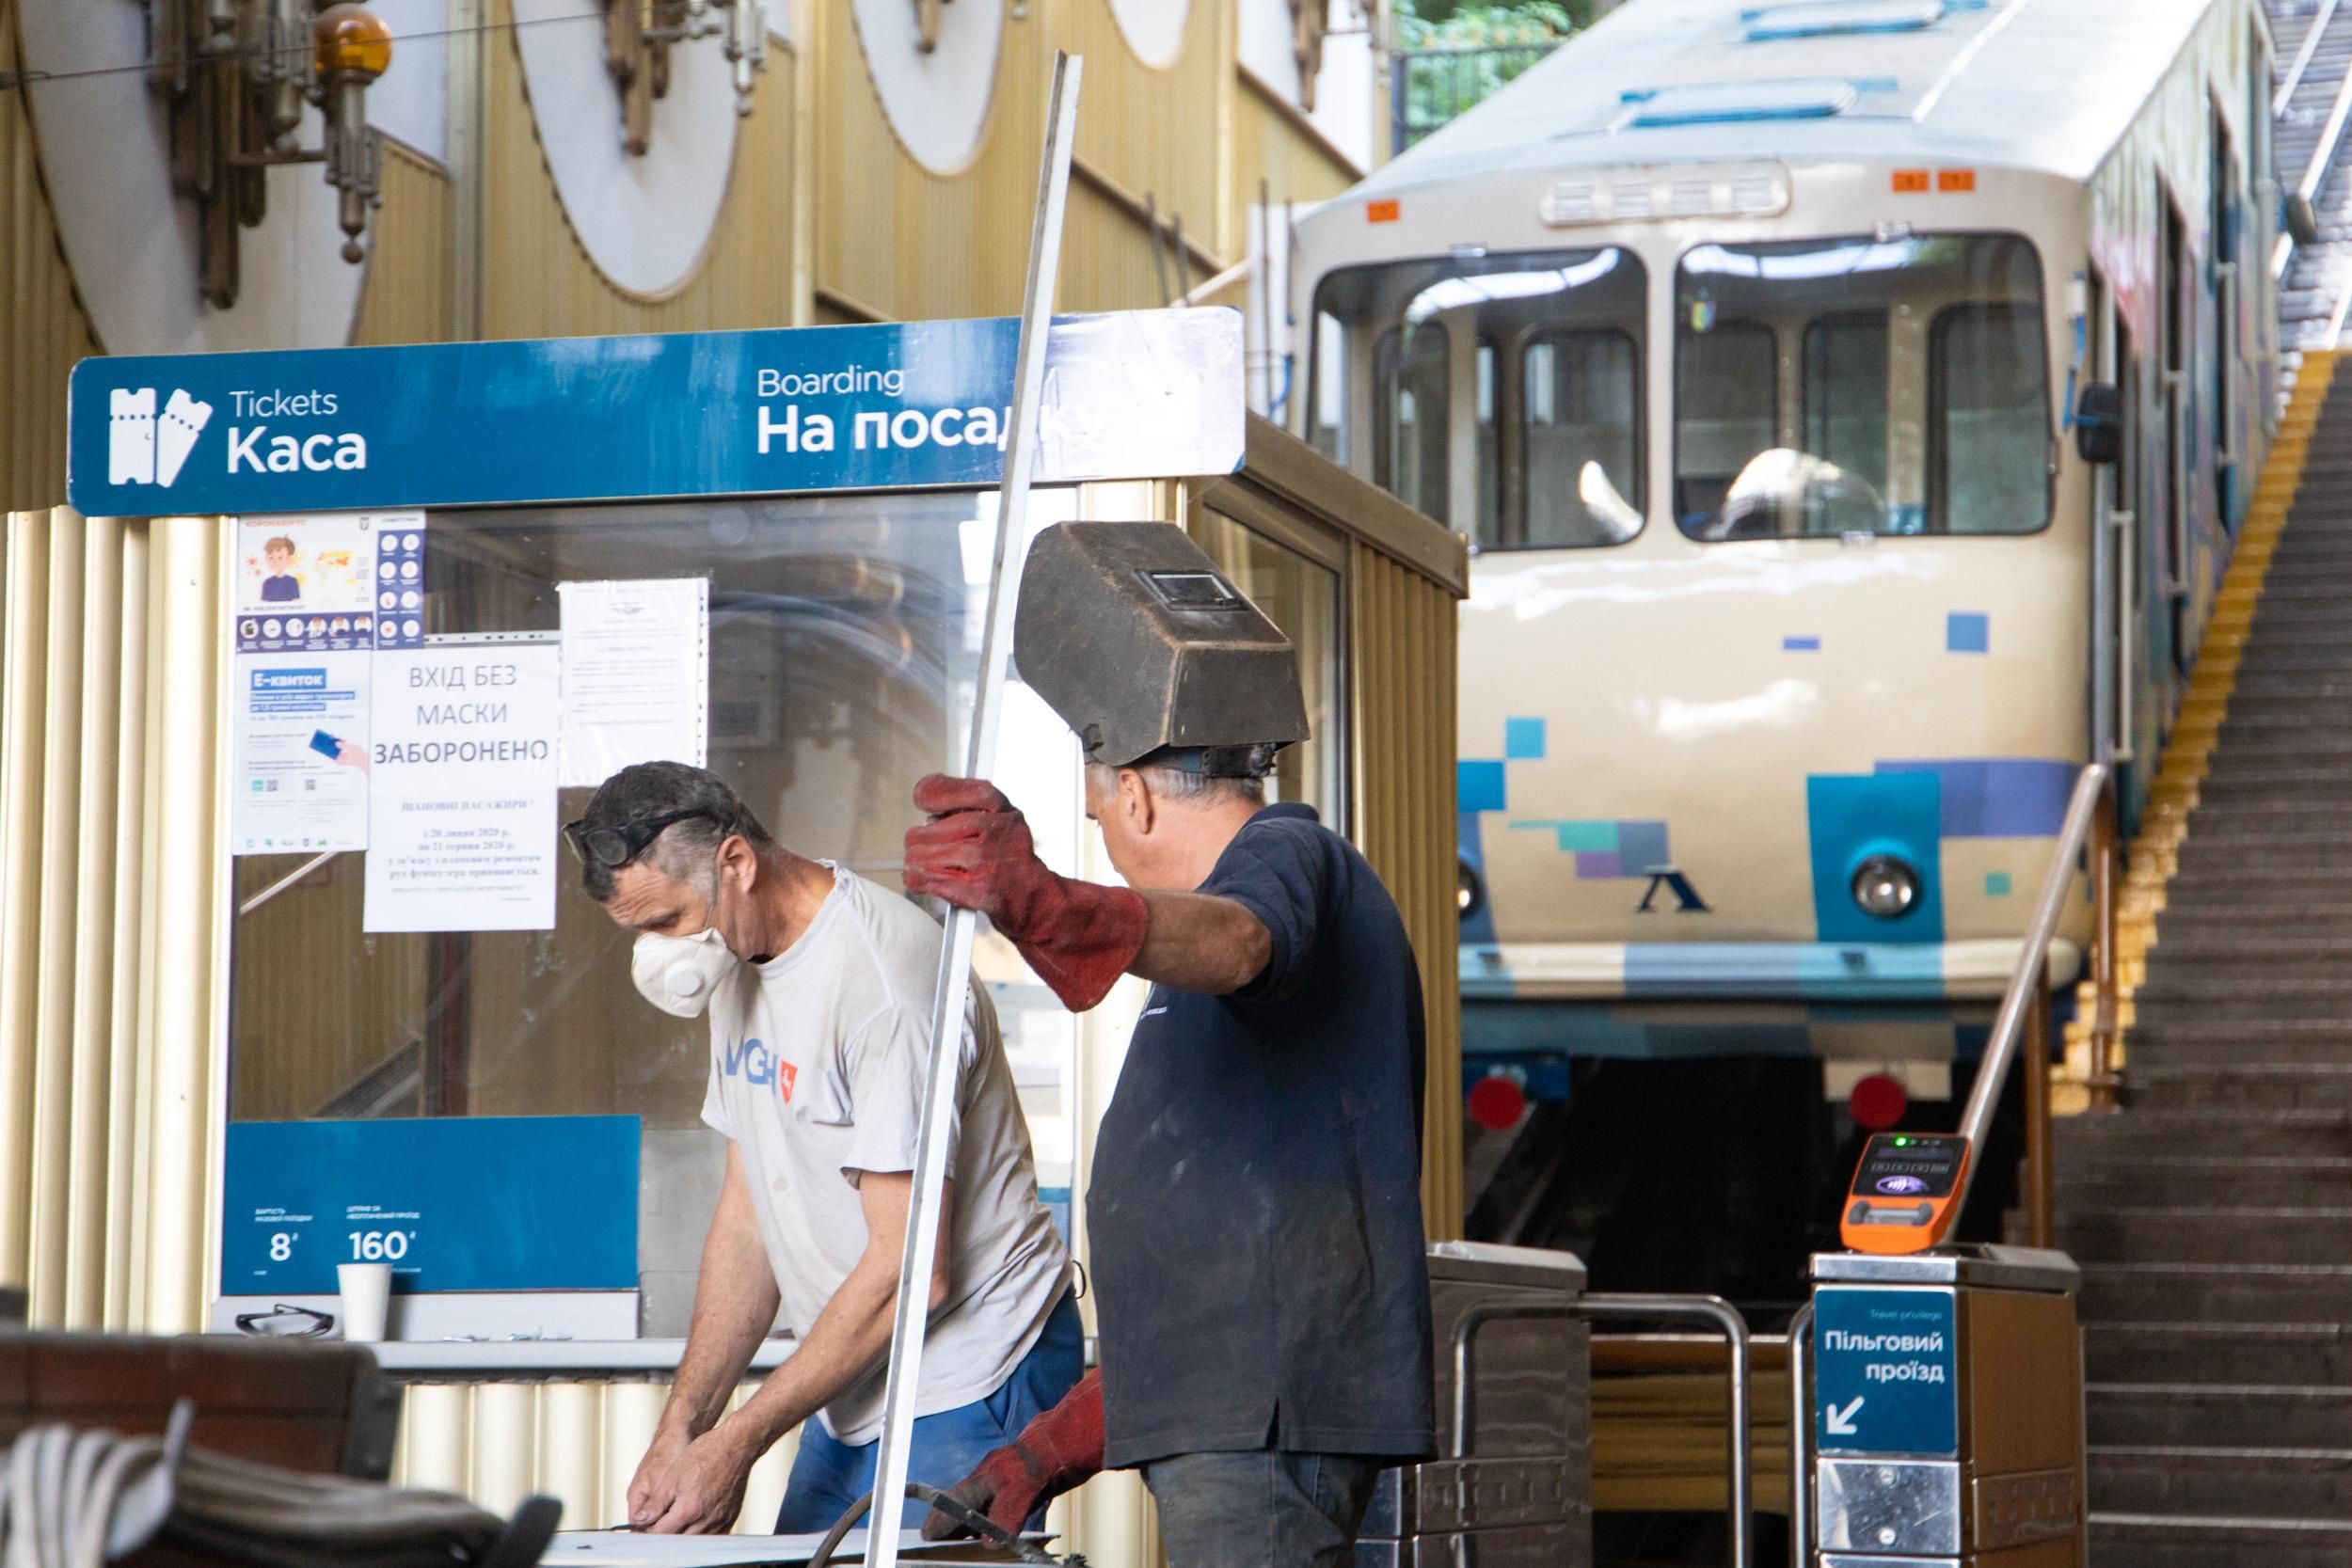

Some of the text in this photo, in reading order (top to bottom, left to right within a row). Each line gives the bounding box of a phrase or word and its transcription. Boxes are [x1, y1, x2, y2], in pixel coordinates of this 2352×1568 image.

[756, 364, 906, 397] Boarding
[228, 388, 339, 418] Tickets
[756, 404, 835, 454] На
[227, 425, 368, 474] Каса
[409, 664, 517, 691] ВХІД БЕЗ
[417, 703, 508, 726] МАСКИ
[373, 739, 549, 764] ЗАБОРОНЕНО
[1824, 1329, 1944, 1353] Пільговий
[1865, 1359, 1946, 1384] проїзд
